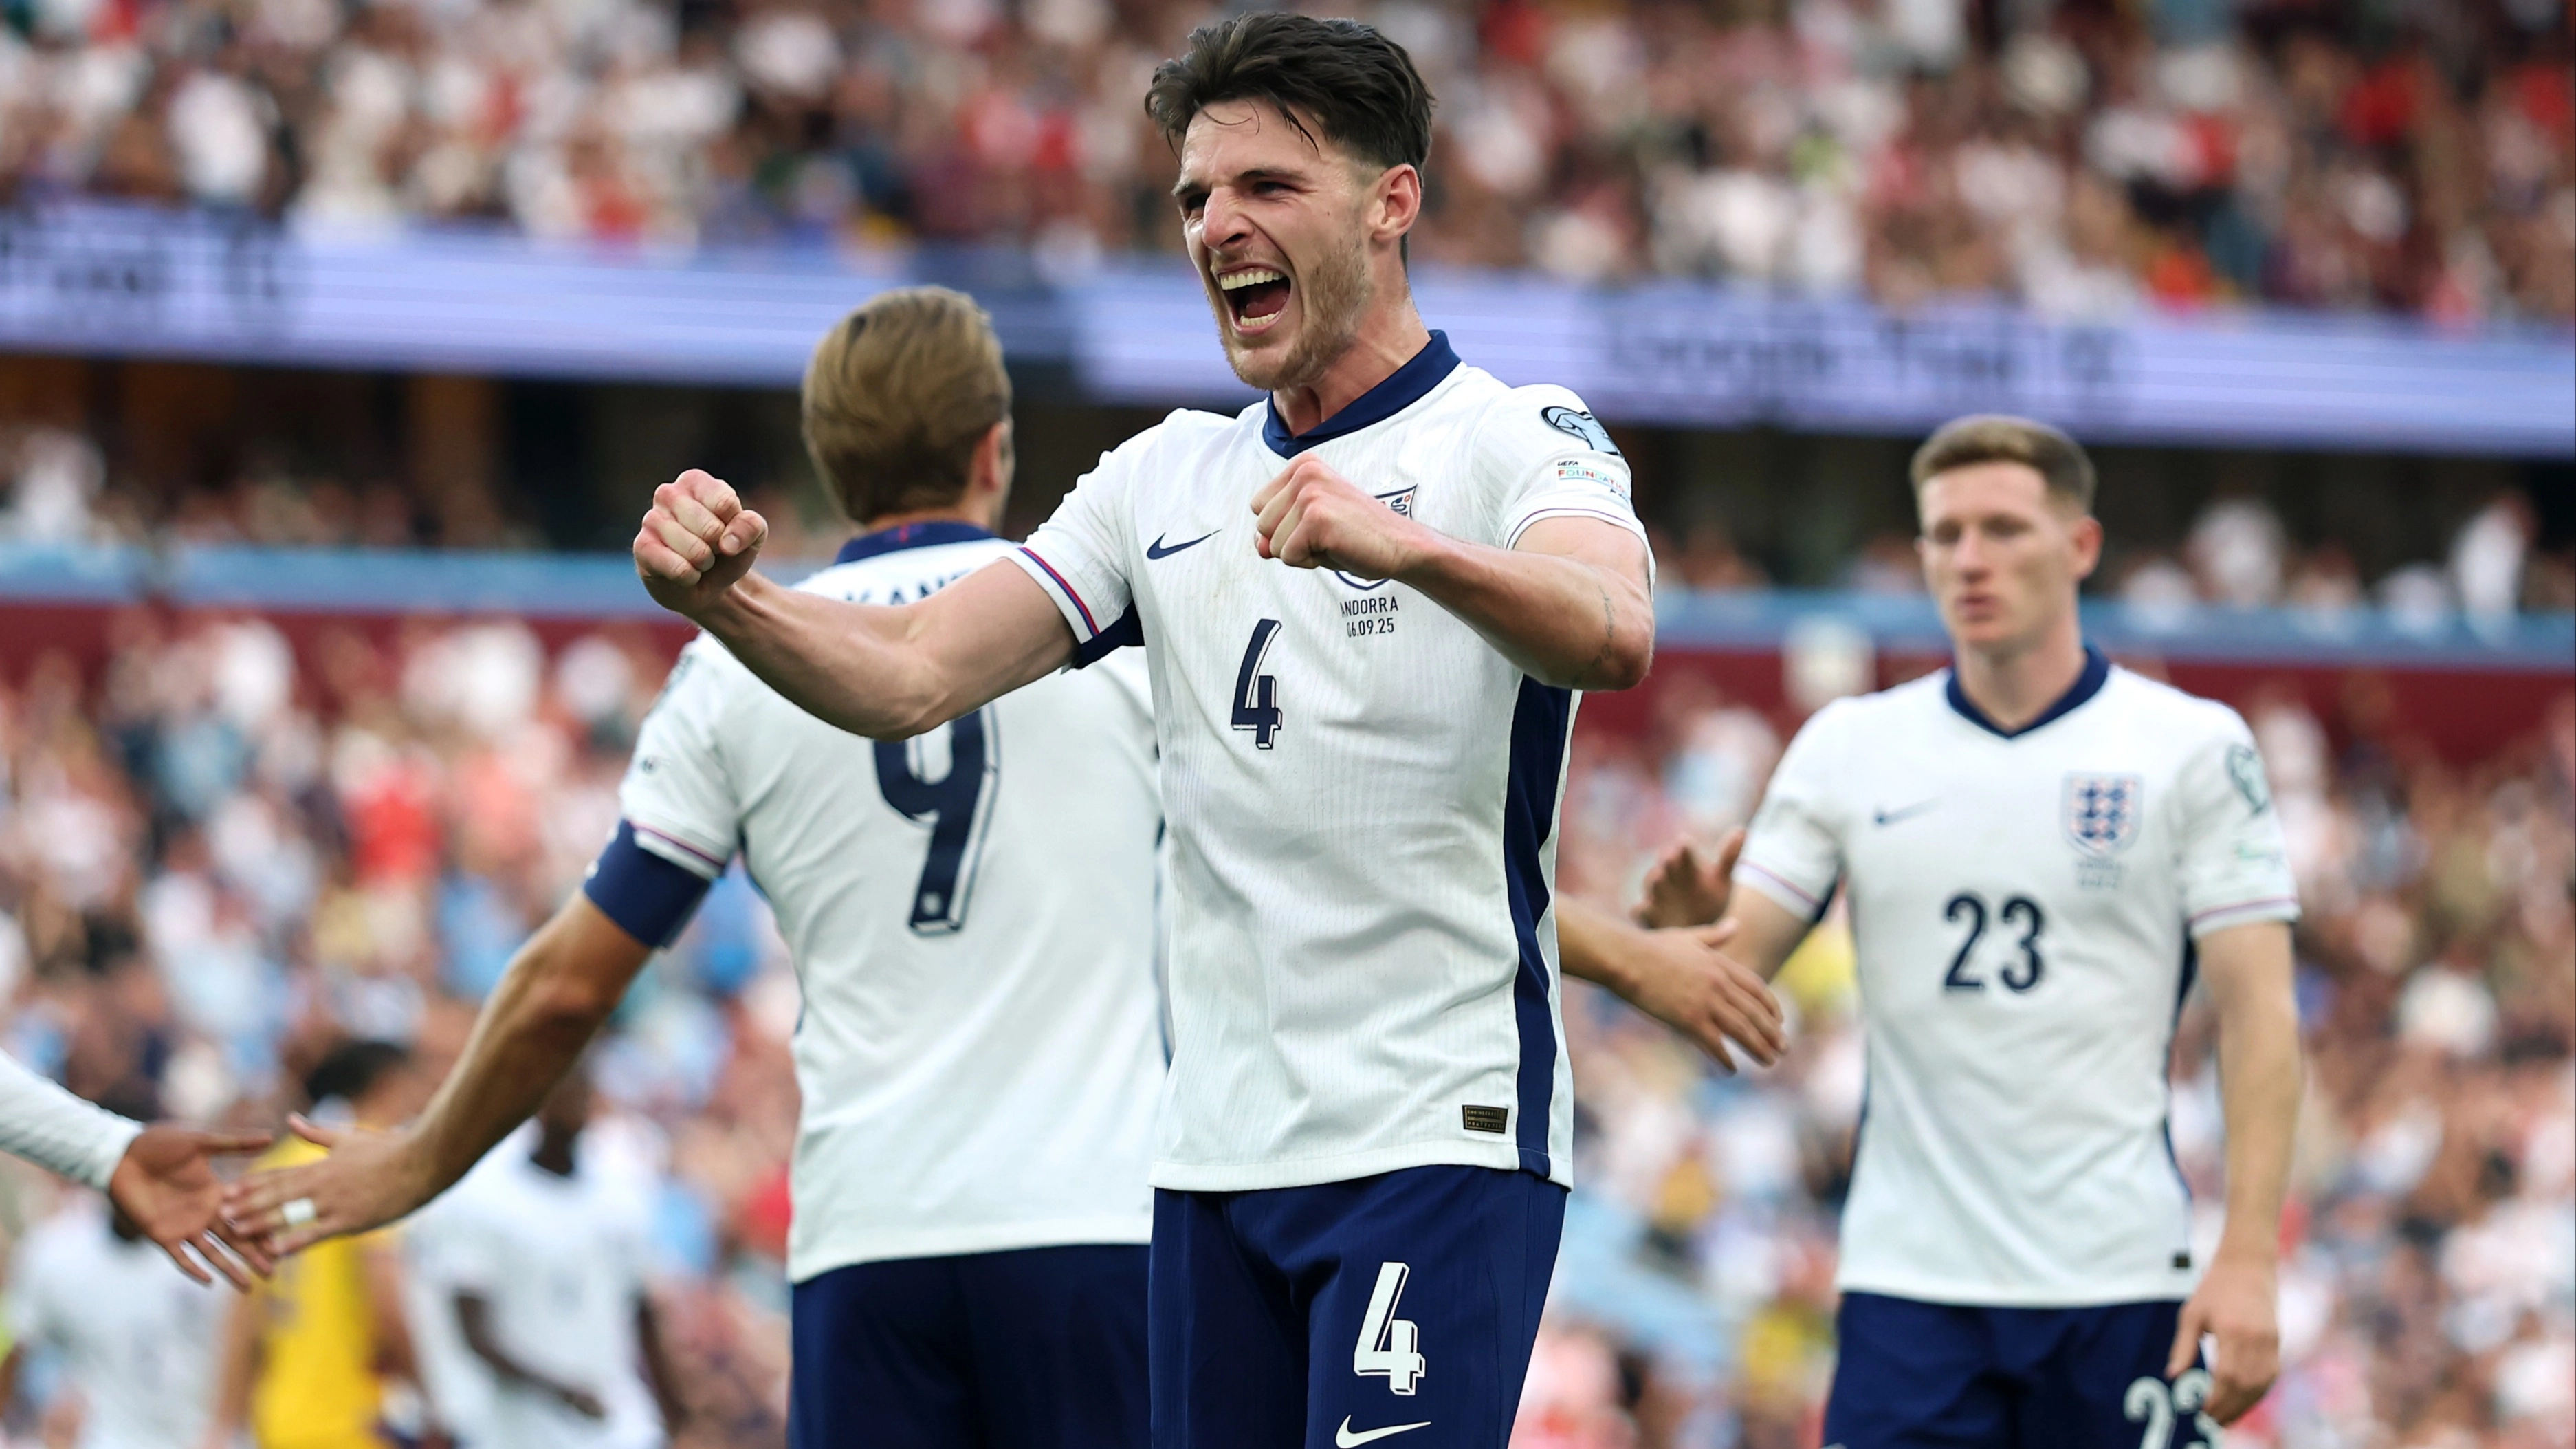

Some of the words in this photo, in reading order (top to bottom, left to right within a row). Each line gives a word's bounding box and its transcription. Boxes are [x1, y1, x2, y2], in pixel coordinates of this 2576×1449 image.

[1339, 596, 1399, 618] ANDORRA
[1346, 617, 1395, 638] 06.09.25
[1231, 618, 1282, 750] 4
[872, 703, 1002, 937] 9
[1943, 891, 2046, 994] 23
[1354, 1261, 1426, 1396] 4
